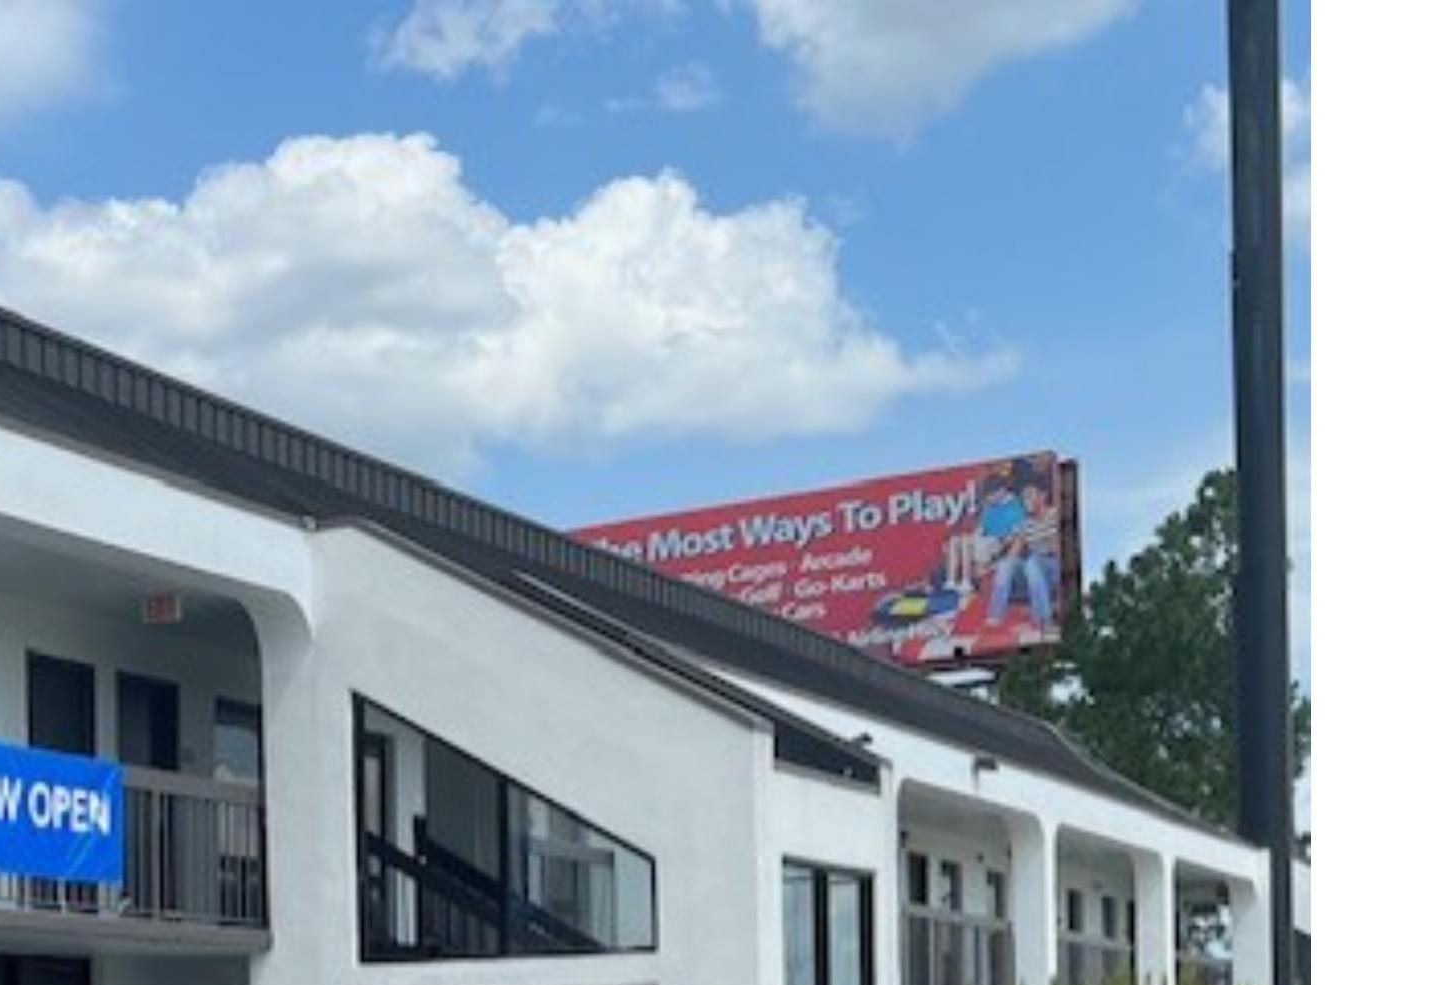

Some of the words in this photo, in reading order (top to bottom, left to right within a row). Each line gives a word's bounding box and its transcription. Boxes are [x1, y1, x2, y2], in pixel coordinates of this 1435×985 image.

[646, 524, 734, 563] Most
[739, 511, 833, 549] Ways
[837, 501, 881, 532] To
[888, 480, 976, 525] Play!
[799, 546, 873, 573] Arcade
[28, 782, 111, 835] OPEN
